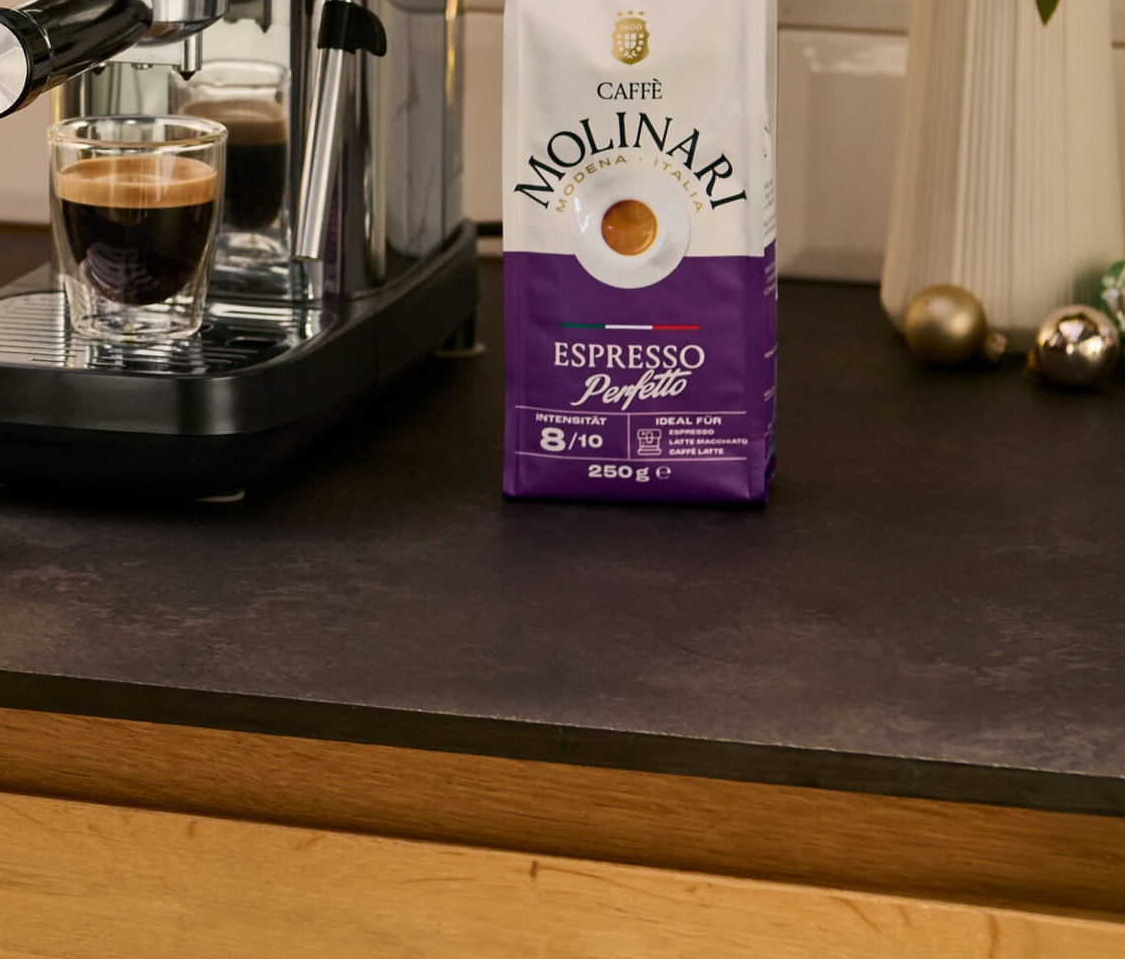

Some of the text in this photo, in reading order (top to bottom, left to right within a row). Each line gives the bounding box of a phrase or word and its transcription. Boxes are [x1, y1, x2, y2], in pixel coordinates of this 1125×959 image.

[597, 78, 662, 100] CAFFÈ
[514, 111, 747, 210] MOLINARI
[555, 155, 627, 213] MODENA
[653, 158, 703, 213] ITALIA
[554, 342, 705, 370] ESPRESSO
[570, 368, 692, 411] Perfetto
[535, 413, 607, 426] INTENSITÄT
[655, 415, 722, 426] IDEAL FÜR
[668, 447, 724, 455] CAFFÈ LATTE
